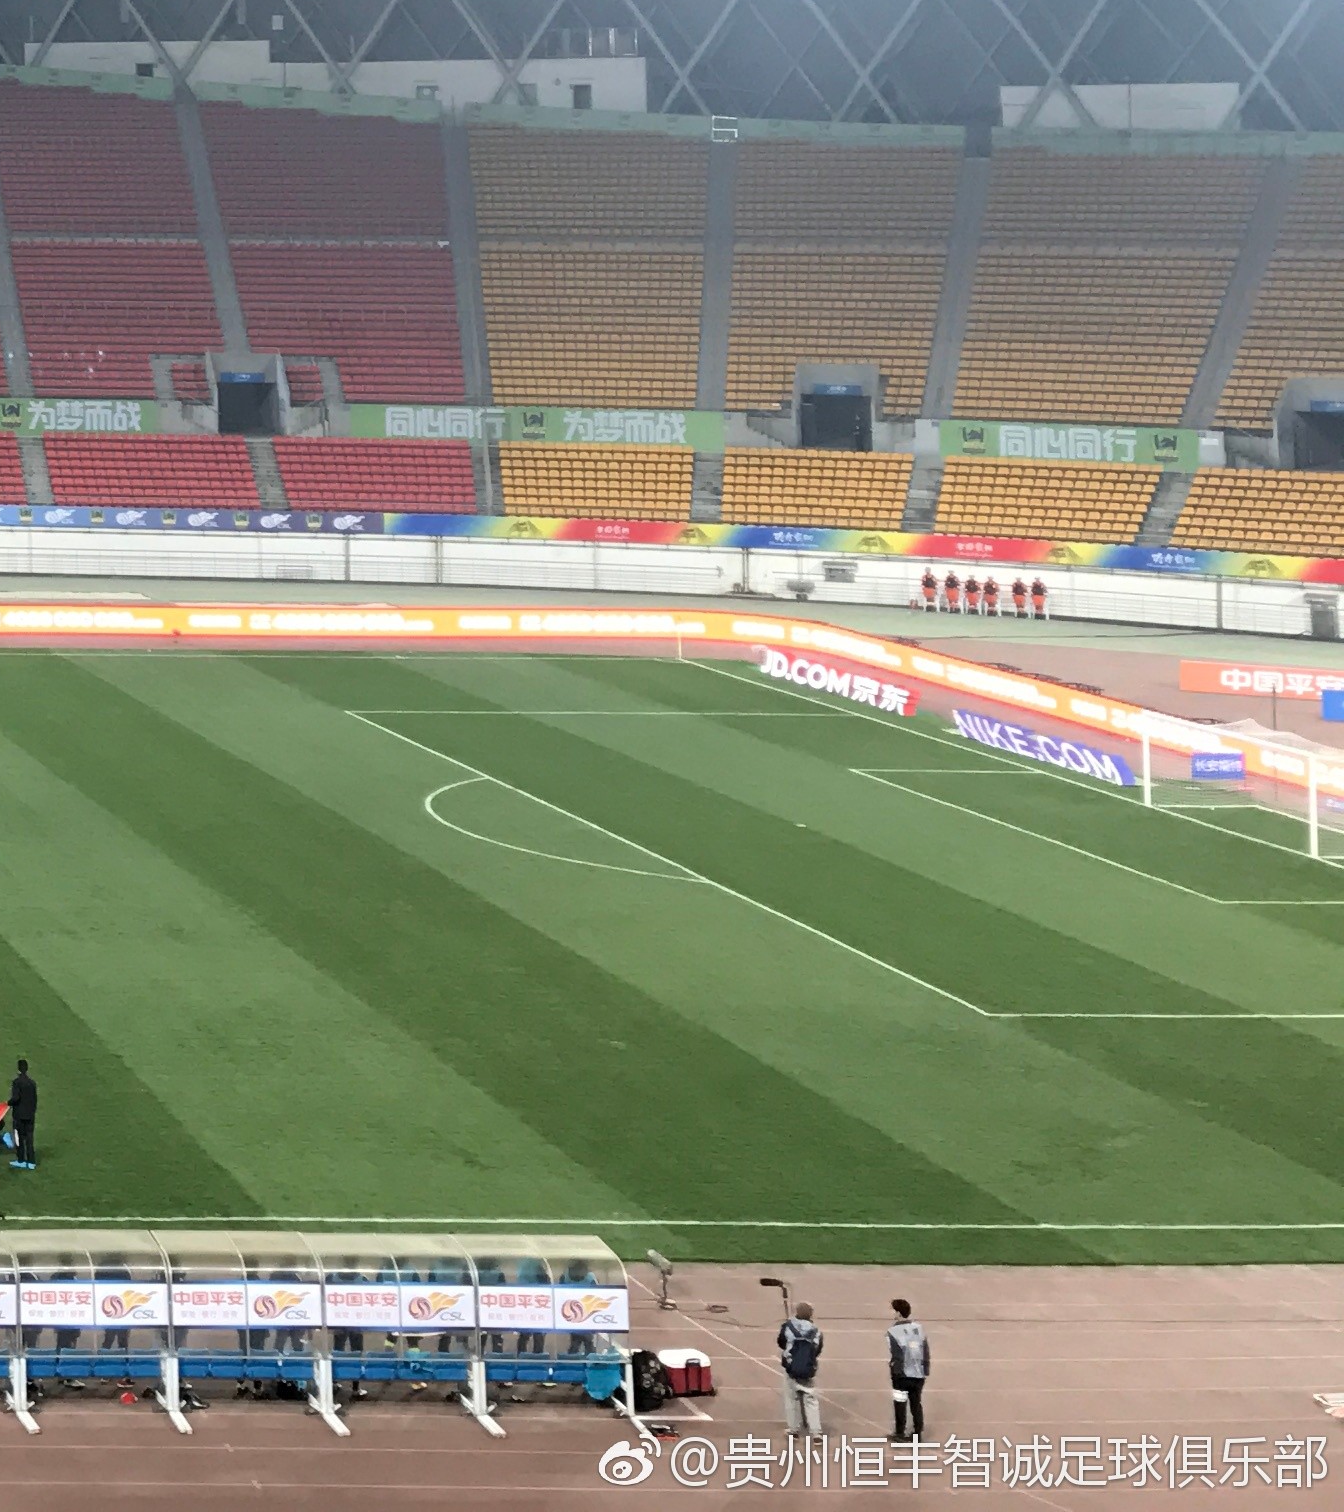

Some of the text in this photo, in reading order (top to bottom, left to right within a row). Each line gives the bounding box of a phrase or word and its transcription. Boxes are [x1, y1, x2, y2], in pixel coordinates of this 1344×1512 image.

[27, 399, 142, 432] 为梦而战
[385, 406, 506, 440] 同心同行
[563, 409, 687, 445] 为梦而战
[999, 424, 1137, 462] 同心同行
[759, 648, 911, 716] JD.COM京东
[952, 710, 1122, 785] NIKE.COM
[21, 1290, 92, 1305] 中国平安
[173, 1291, 244, 1306] 中国平安
[327, 1292, 398, 1308] 中国平安
[480, 1293, 552, 1309] 中国平安
[132, 1309, 158, 1320] CSL
[284, 1309, 311, 1321] CSL
[439, 1311, 466, 1322] CSL
[592, 1313, 619, 1325] CSL
